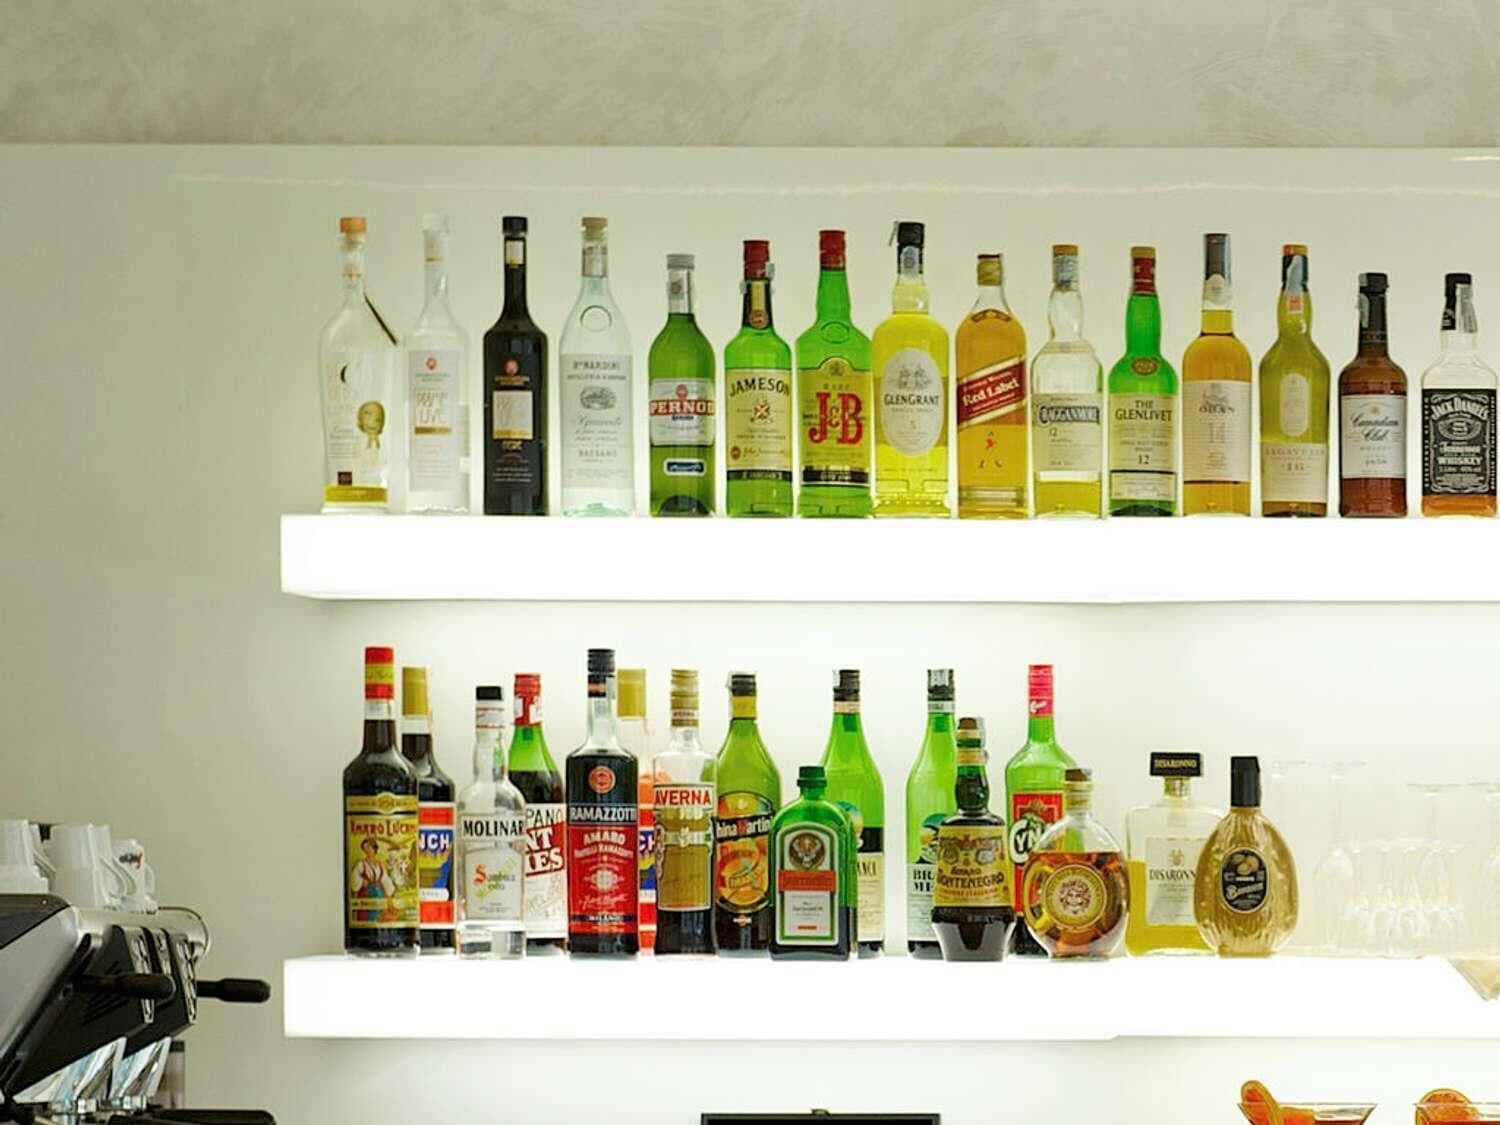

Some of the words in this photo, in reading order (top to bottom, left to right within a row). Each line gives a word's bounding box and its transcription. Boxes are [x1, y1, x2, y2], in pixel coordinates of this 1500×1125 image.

[730, 377, 790, 397] JAMESON
[1135, 400, 1154, 408] THE
[1115, 409, 1173, 422] GLENLIVET
[1138, 454, 1150, 465] 12
[654, 790, 711, 806] AVERNA
[583, 831, 626, 848] AMARO
